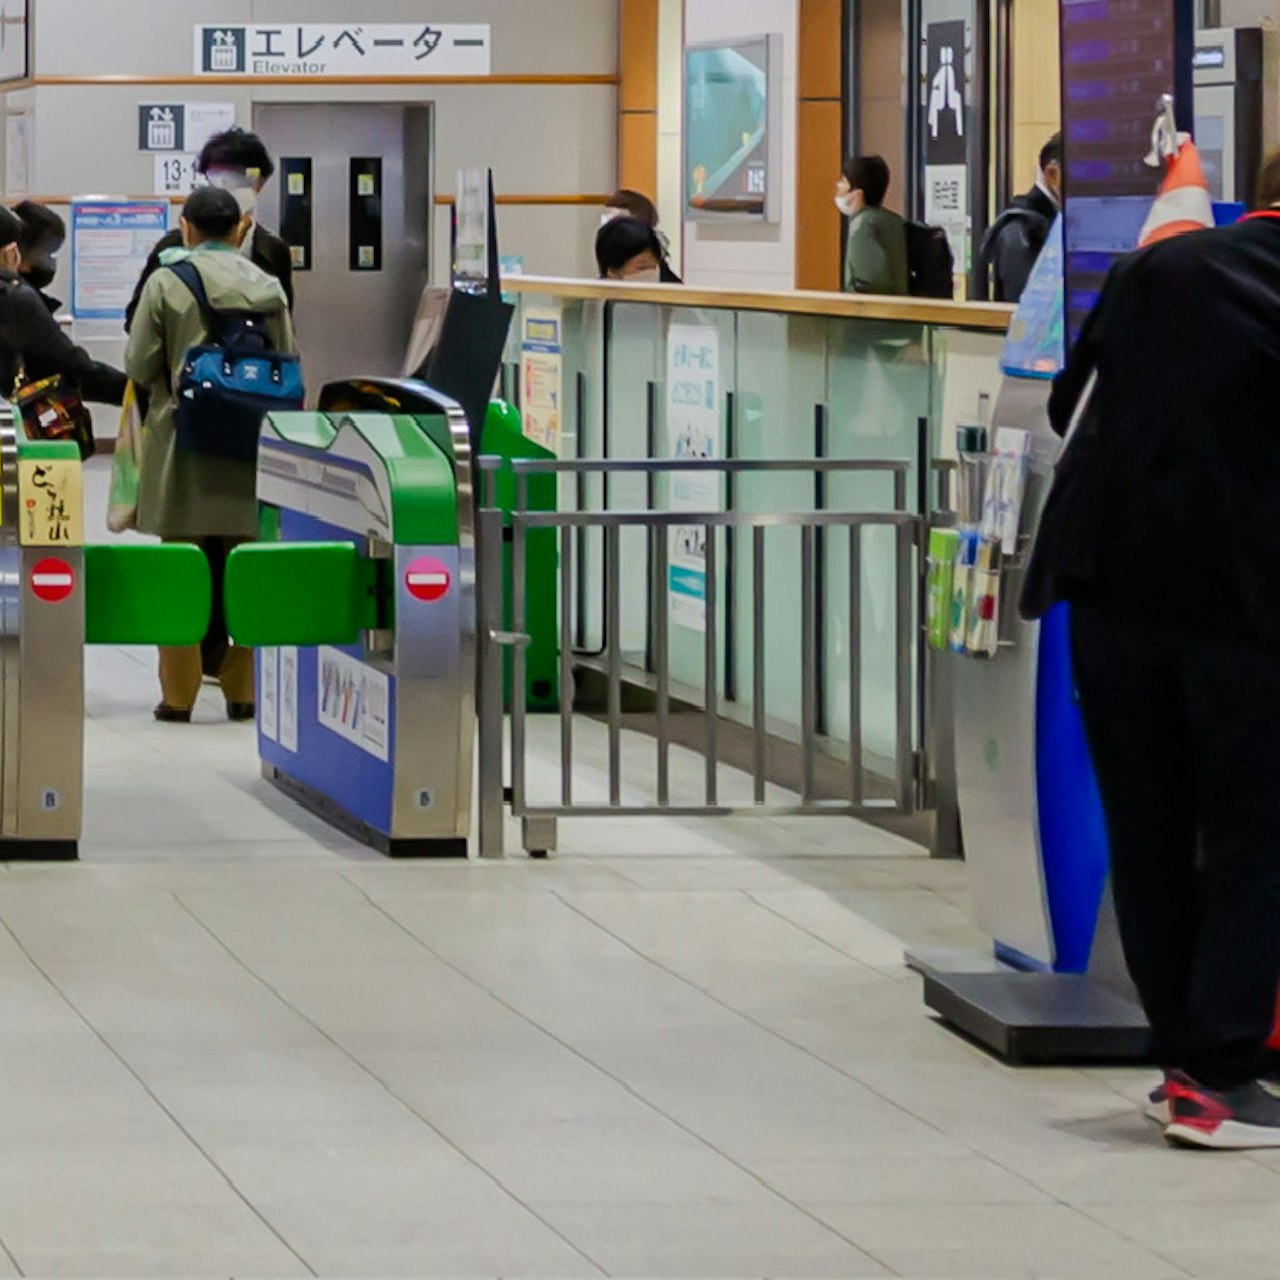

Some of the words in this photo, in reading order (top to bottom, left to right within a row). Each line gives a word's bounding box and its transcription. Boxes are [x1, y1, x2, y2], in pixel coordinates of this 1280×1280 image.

[252, 26, 485, 60] エレベーター
[253, 59, 327, 75] Elevator
